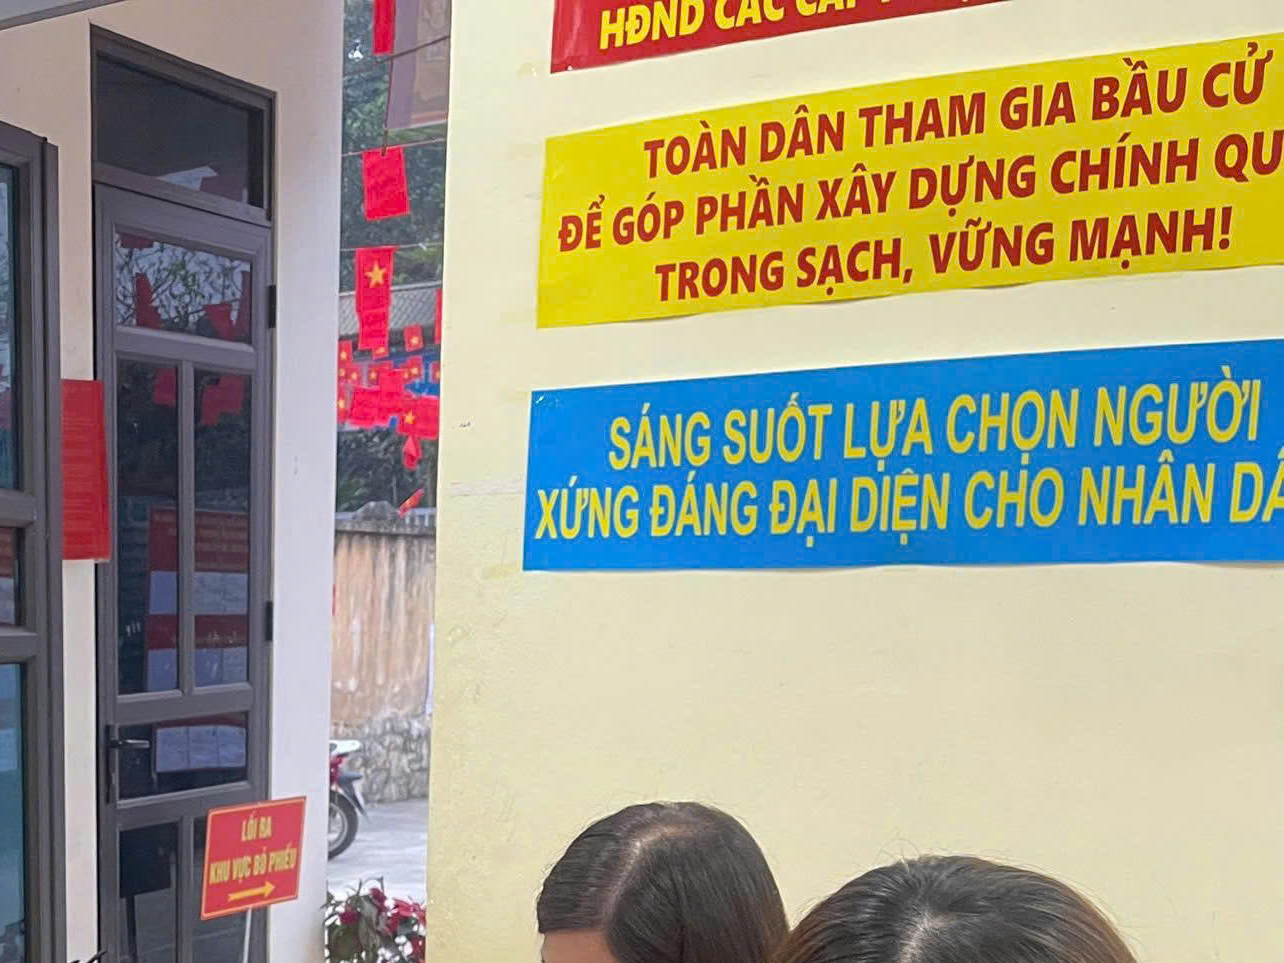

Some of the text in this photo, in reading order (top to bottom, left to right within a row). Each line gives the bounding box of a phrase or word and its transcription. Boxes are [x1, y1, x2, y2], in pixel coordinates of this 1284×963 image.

[599, 0, 705, 50] HĐND
[643, 41, 1274, 179] TOÀN DÂN THAM GIA BẦU CỬ
[558, 194, 606, 253] ĐỂ
[612, 191, 685, 246] GÓP
[695, 173, 804, 236] PHẦN
[816, 162, 897, 221] XÂY
[908, 154, 1036, 217] DỰNG
[1050, 131, 1200, 195] CHÍNH
[655, 206, 1233, 302] TRONG SẠCH, VỮNG MẠNH!
[609, 365, 1261, 472] SÁNG SUỐT LỰA CHỌN NGƯỜI
[535, 475, 639, 539] XỨNG
[649, 470, 758, 537] ĐÁNG
[769, 477, 838, 548] ĐẠI
[850, 467, 950, 545] DIỆN
[964, 467, 1063, 529] CHO
[1078, 448, 1215, 525] NHÂN
[209, 841, 297, 884] KHU VỰC BỎ PHIẾU
[241, 810, 272, 841] LỐI RA
